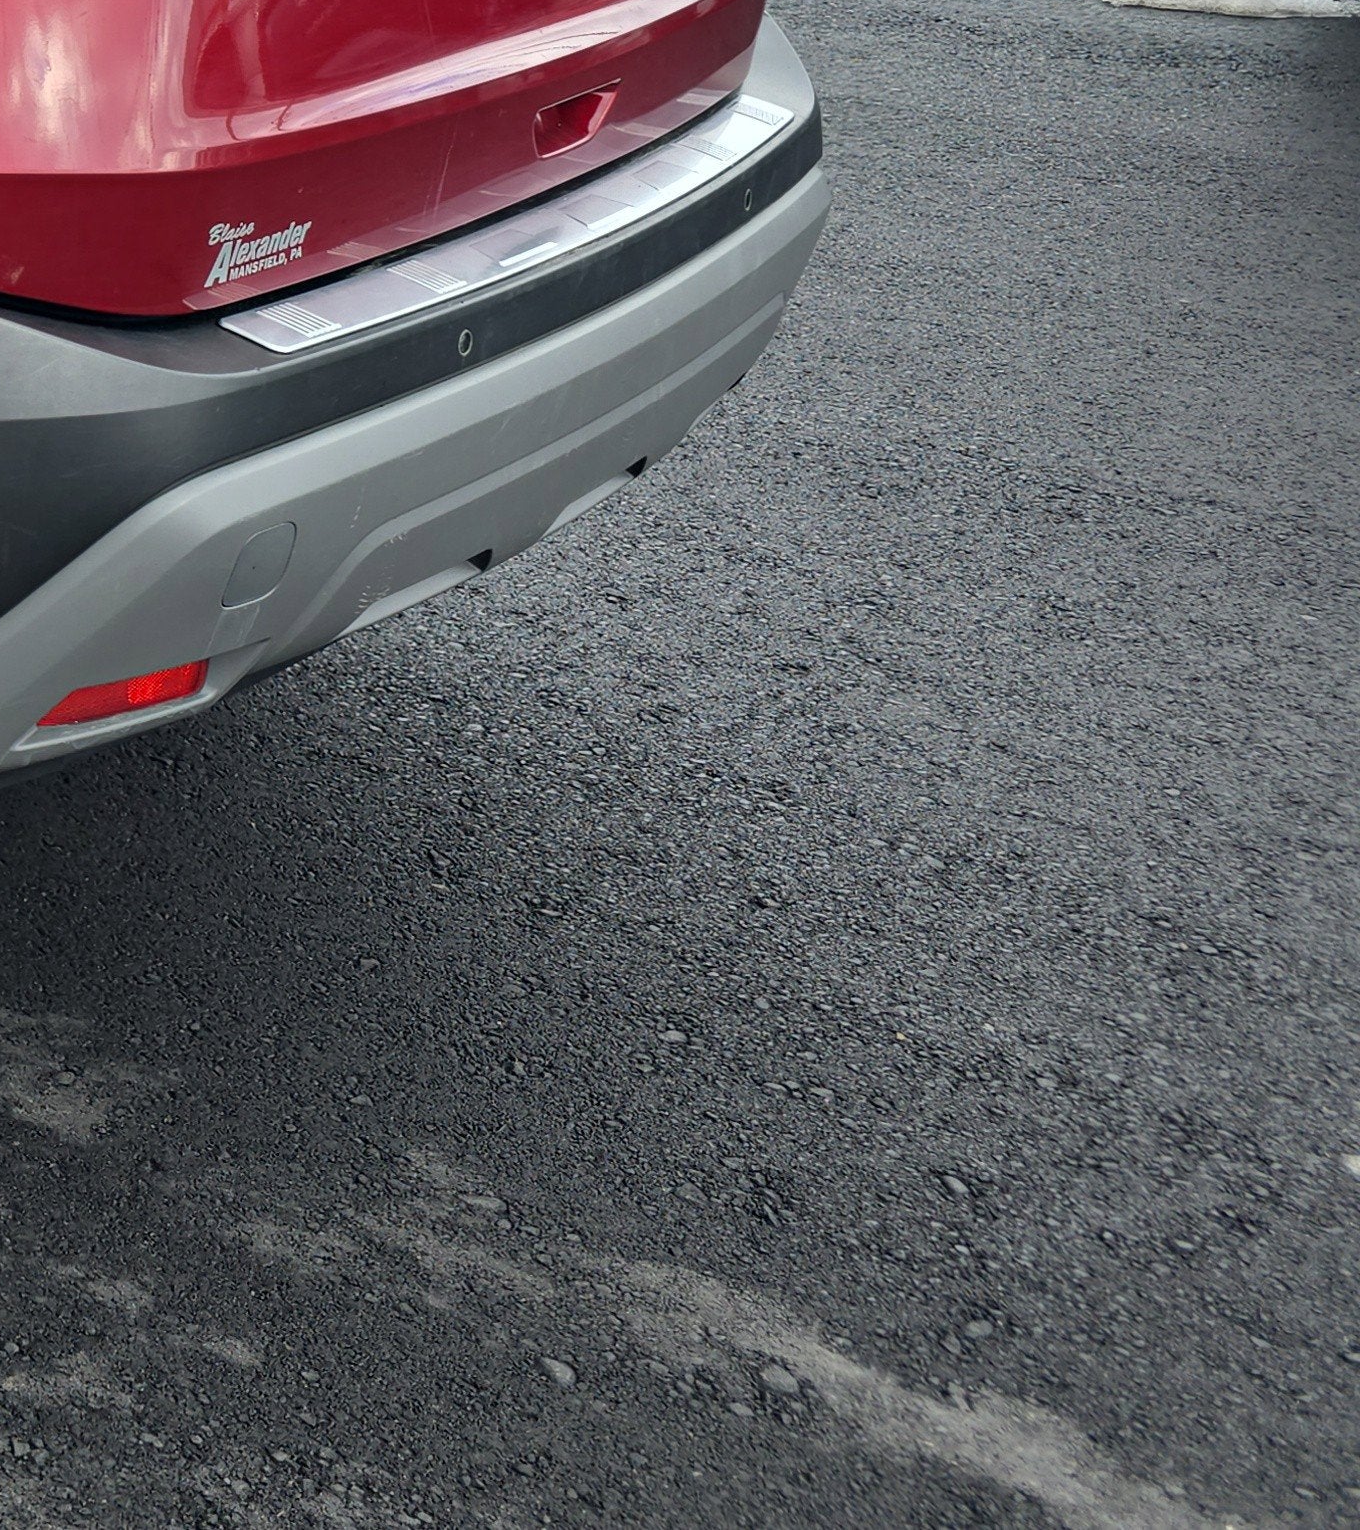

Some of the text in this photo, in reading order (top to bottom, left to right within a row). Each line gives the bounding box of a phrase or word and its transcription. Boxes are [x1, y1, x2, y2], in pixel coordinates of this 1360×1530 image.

[208, 222, 255, 246] Blaise
[203, 220, 313, 288] Alexander
[229, 245, 302, 281] MANSFIELD, PA
